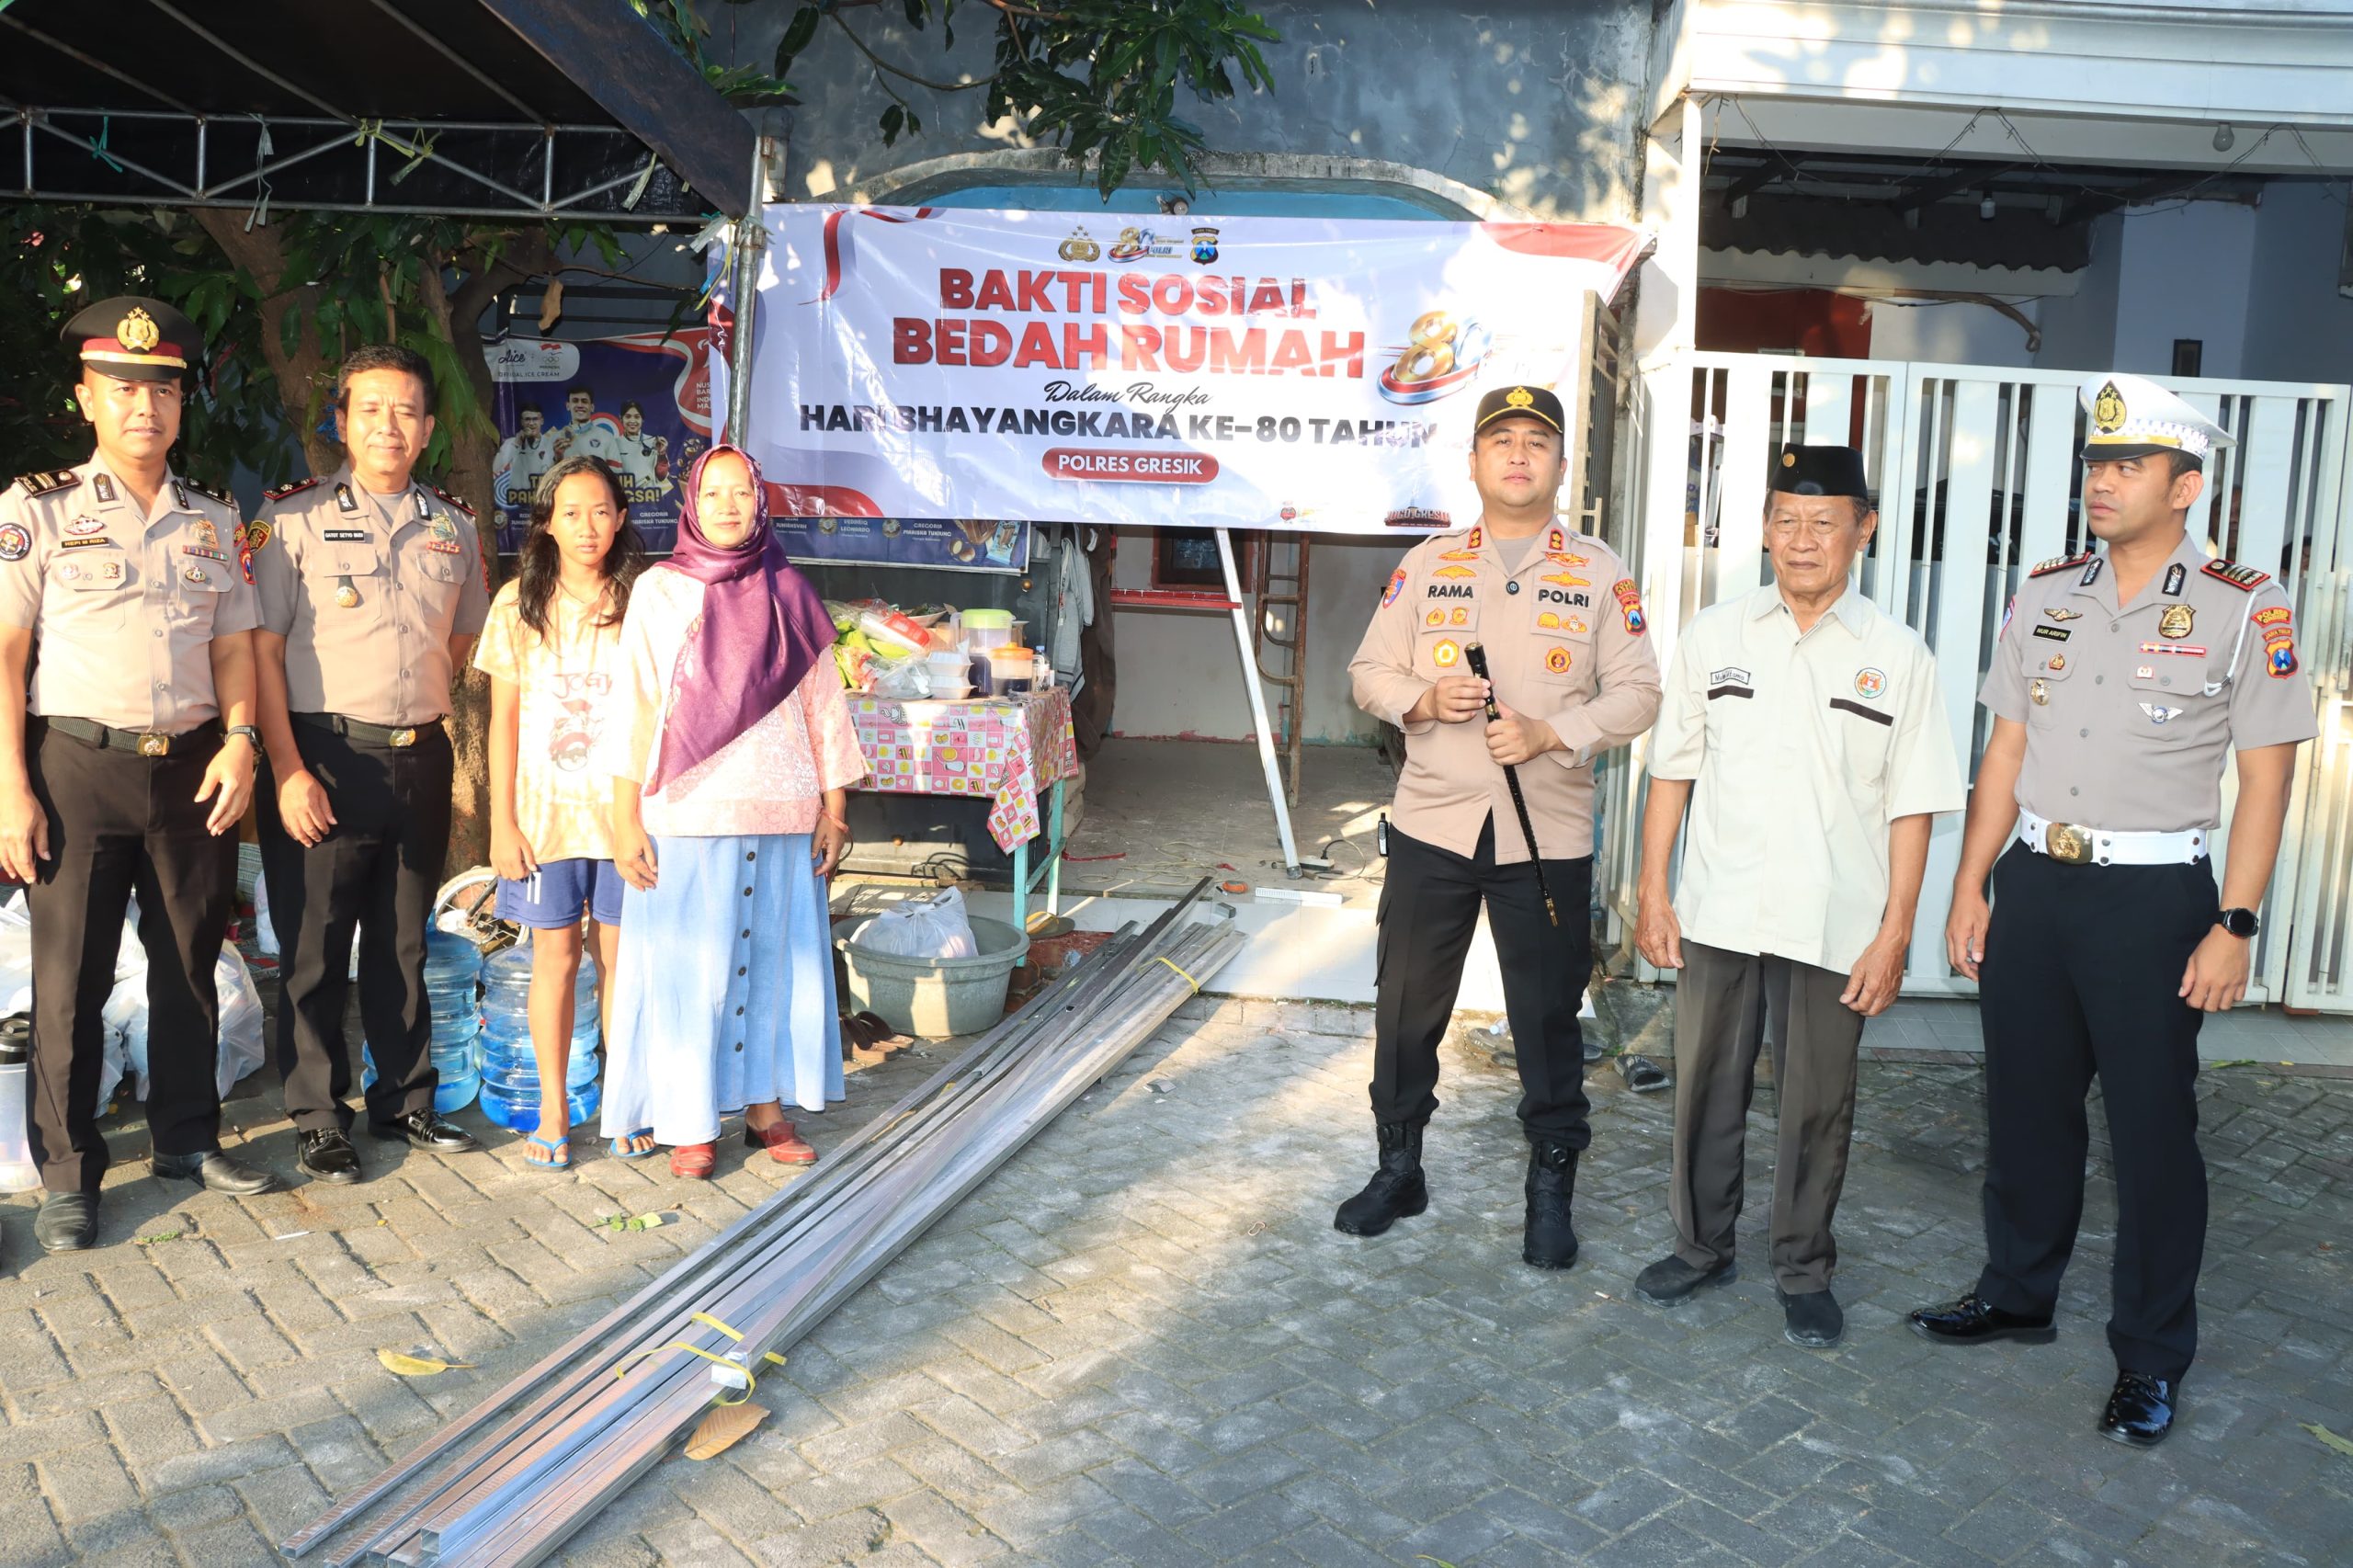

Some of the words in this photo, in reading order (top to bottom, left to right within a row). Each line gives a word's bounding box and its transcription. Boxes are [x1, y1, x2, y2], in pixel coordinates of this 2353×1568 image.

[939, 267, 1108, 313] BAKTI
[1118, 273, 1317, 320] SOSIAL
[498, 349, 526, 364] Aice
[892, 316, 1108, 370] BEDAH
[1121, 323, 1366, 380] RUMAH
[1043, 380, 1126, 403] Dalam
[1126, 381, 1213, 414] Rangka
[800, 404, 887, 433] HARI
[889, 404, 1182, 439] BHAYANGKARA
[1188, 415, 1302, 443] KE-80
[1308, 418, 1438, 449] TAHUN
[1058, 454, 1131, 473] POLRES
[1134, 457, 1203, 476] GRESIK
[1427, 585, 1474, 598] RAMA
[1538, 588, 1589, 608] POLRI
[2049, 629, 2068, 639] ARIFIN
[551, 672, 612, 699] JOGJ
